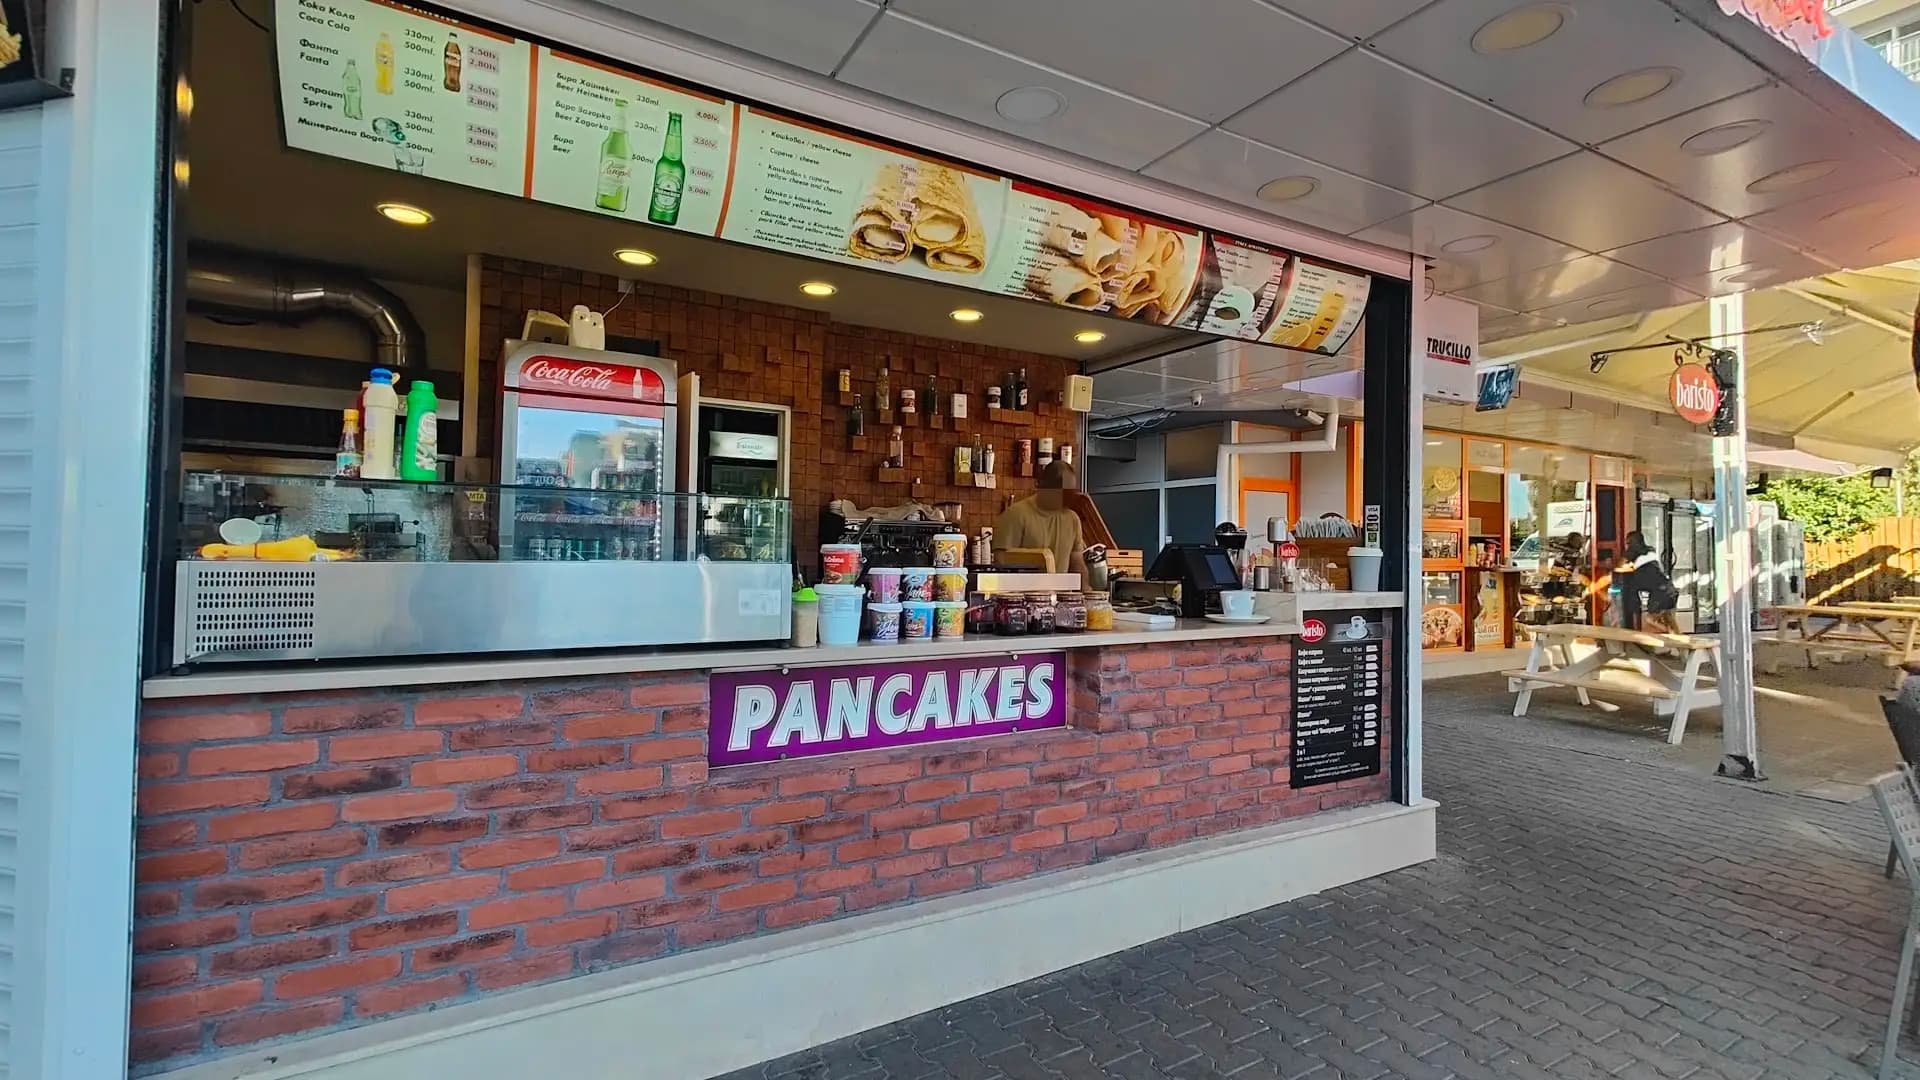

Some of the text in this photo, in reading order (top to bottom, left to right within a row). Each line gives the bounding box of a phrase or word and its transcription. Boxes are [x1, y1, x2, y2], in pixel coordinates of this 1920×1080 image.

[329, 6, 355, 20] Кола
[298, 12, 350, 32] Coca Cola
[299, 39, 338, 55] Фанта
[300, 52, 329, 65] Fanta
[556, 82, 613, 103] Beer Heineken
[303, 97, 333, 110] Sprite
[555, 112, 572, 121] Beer
[554, 134, 574, 144] Бира
[553, 144, 570, 154] Beer
[832, 149, 852, 158] cheese
[800, 156, 819, 165] cheese
[1427, 338, 1471, 359] TRUCILLO
[1676, 374, 1714, 412] baristo
[727, 663, 1054, 752] PANCAKES
